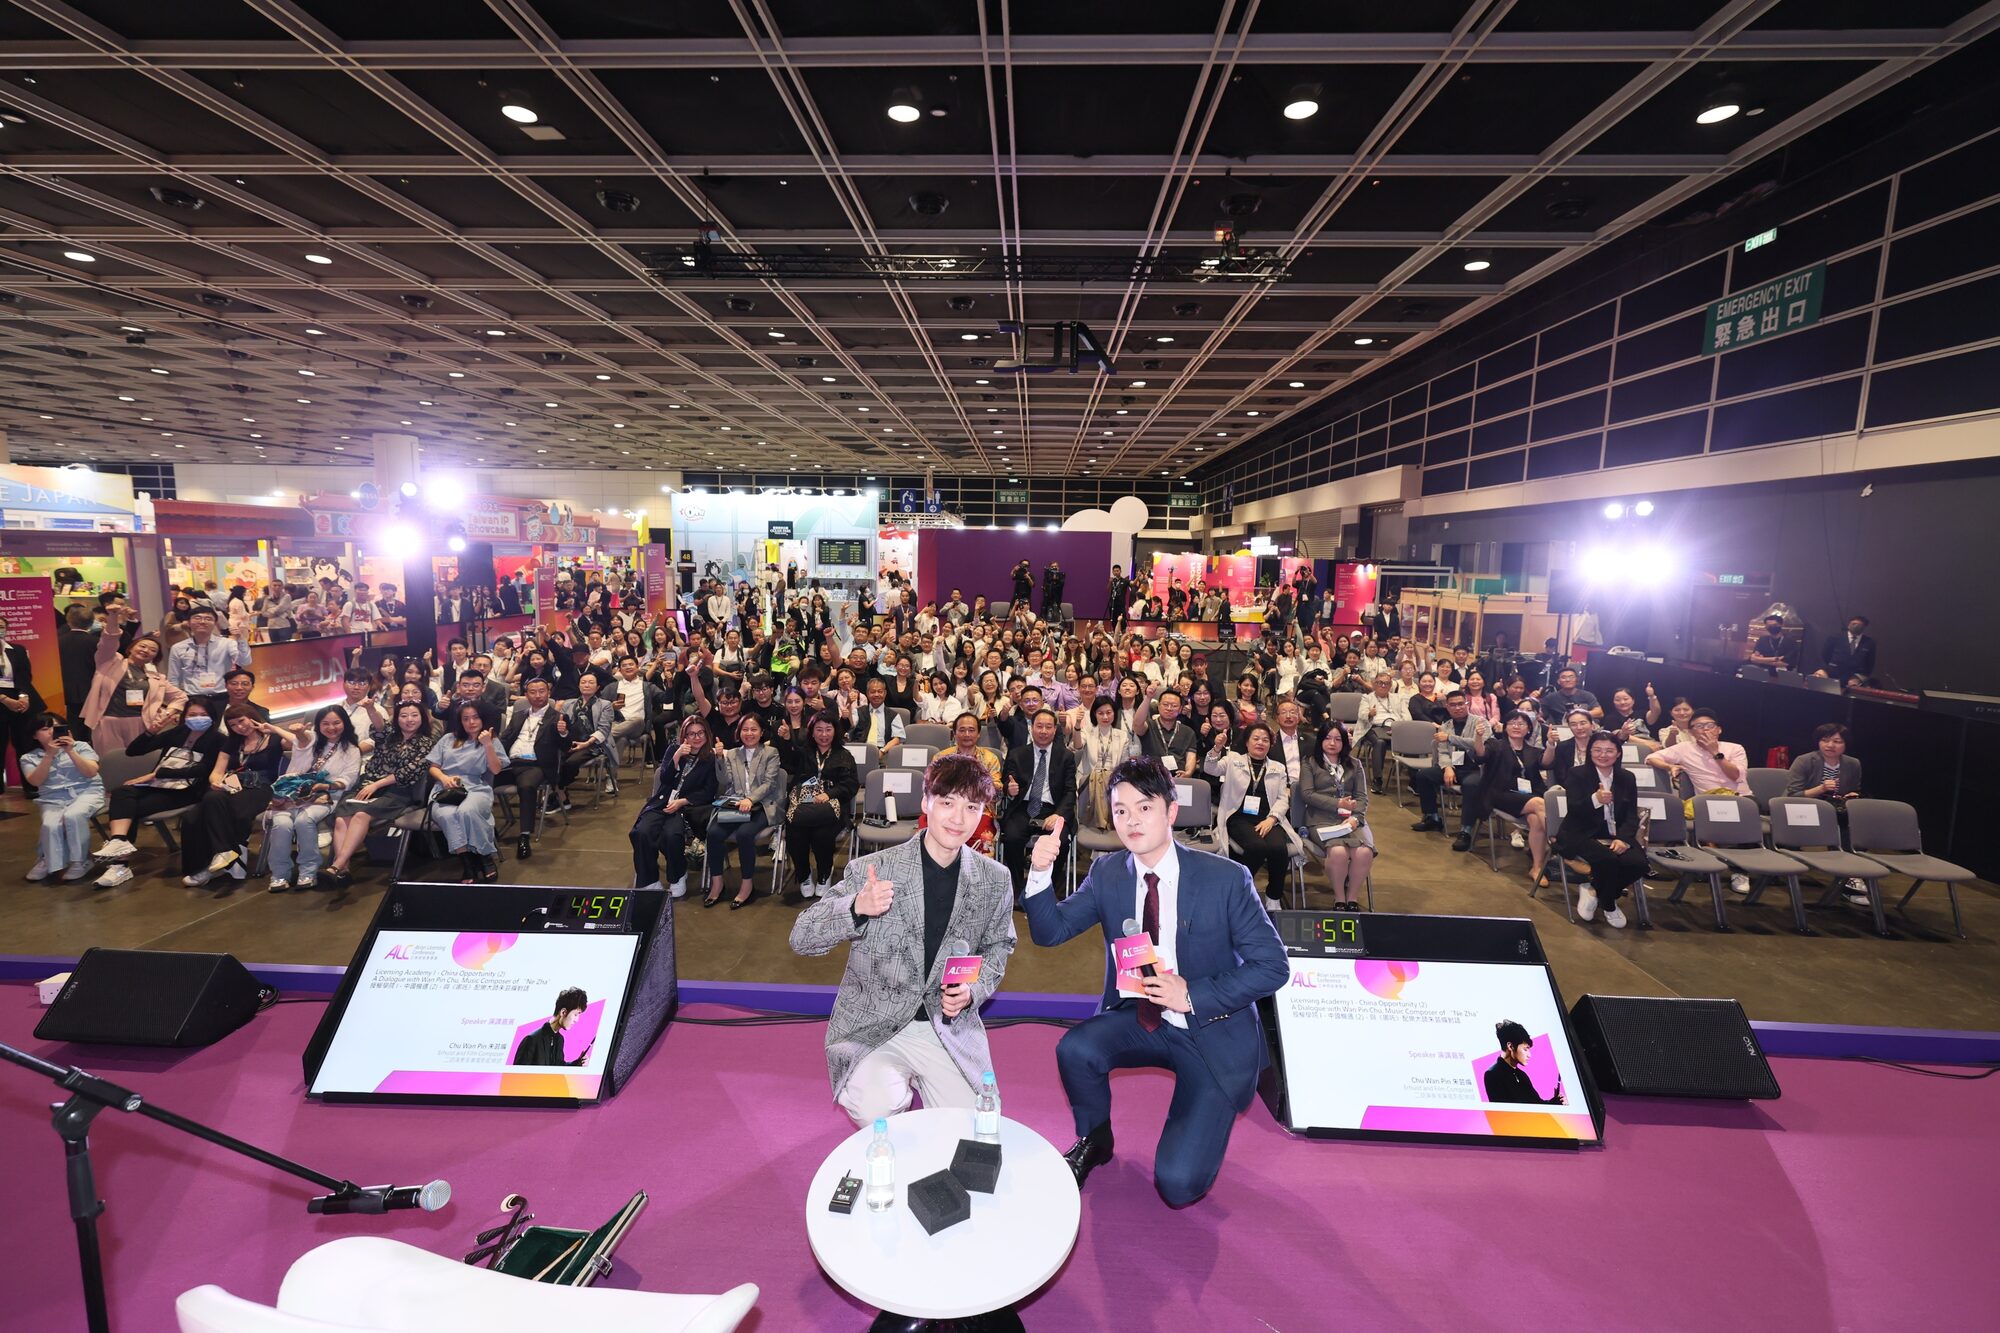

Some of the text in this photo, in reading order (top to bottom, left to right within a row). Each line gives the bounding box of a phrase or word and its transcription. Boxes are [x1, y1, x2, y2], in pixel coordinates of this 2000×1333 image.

[1717, 272, 1812, 320] EMERGENCY EXIT
[1714, 300, 1806, 348] 緊急出口
[468, 524, 510, 534] Showcase
[571, 896, 624, 918] 4:59
[384, 944, 414, 960] ALC
[1292, 972, 1317, 987] ALC
[1408, 1050, 1436, 1059] Speaker
[1743, 1036, 1756, 1056] NEXO
